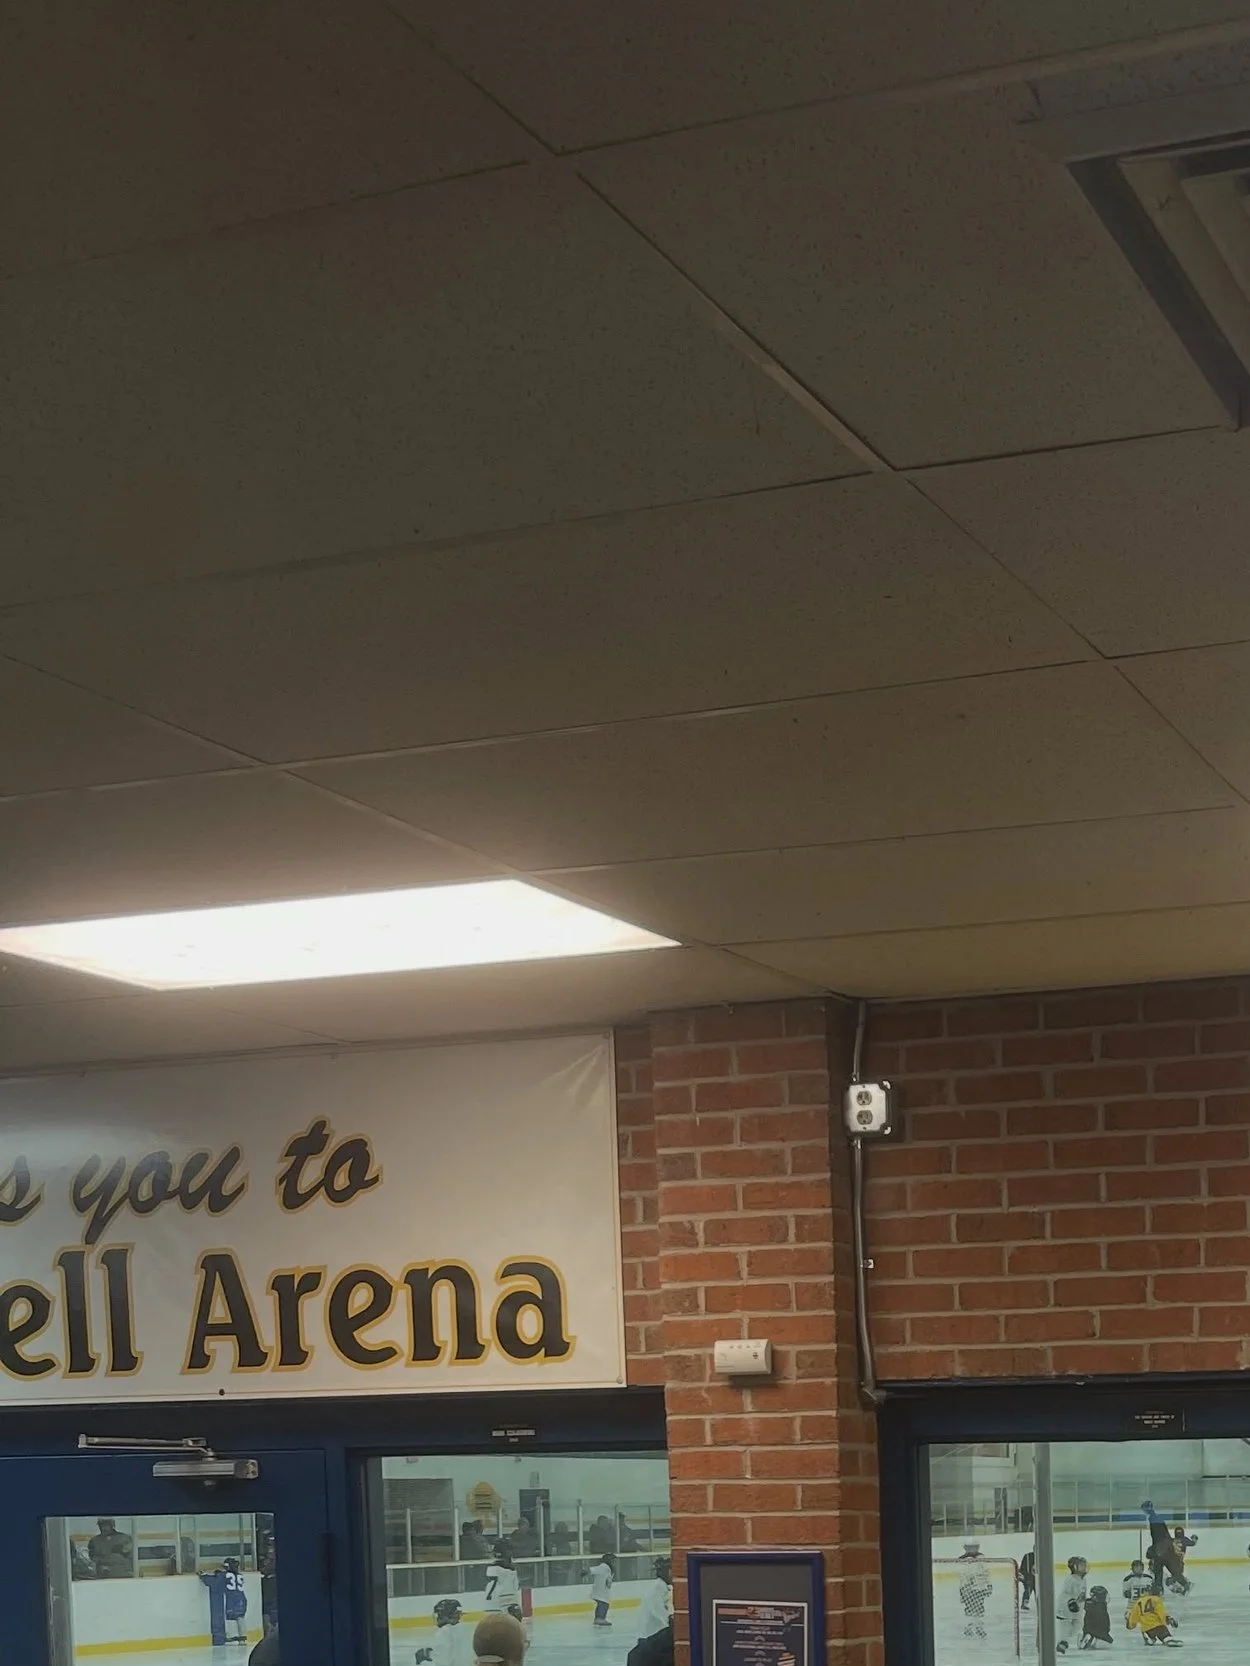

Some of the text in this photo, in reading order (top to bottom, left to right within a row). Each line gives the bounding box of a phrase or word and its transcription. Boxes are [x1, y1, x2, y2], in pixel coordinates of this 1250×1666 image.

[71, 1143, 249, 1246] you
[275, 1115, 384, 1213] to
[180, 1247, 577, 1375] Arena
[225, 1572, 244, 1592] 39
